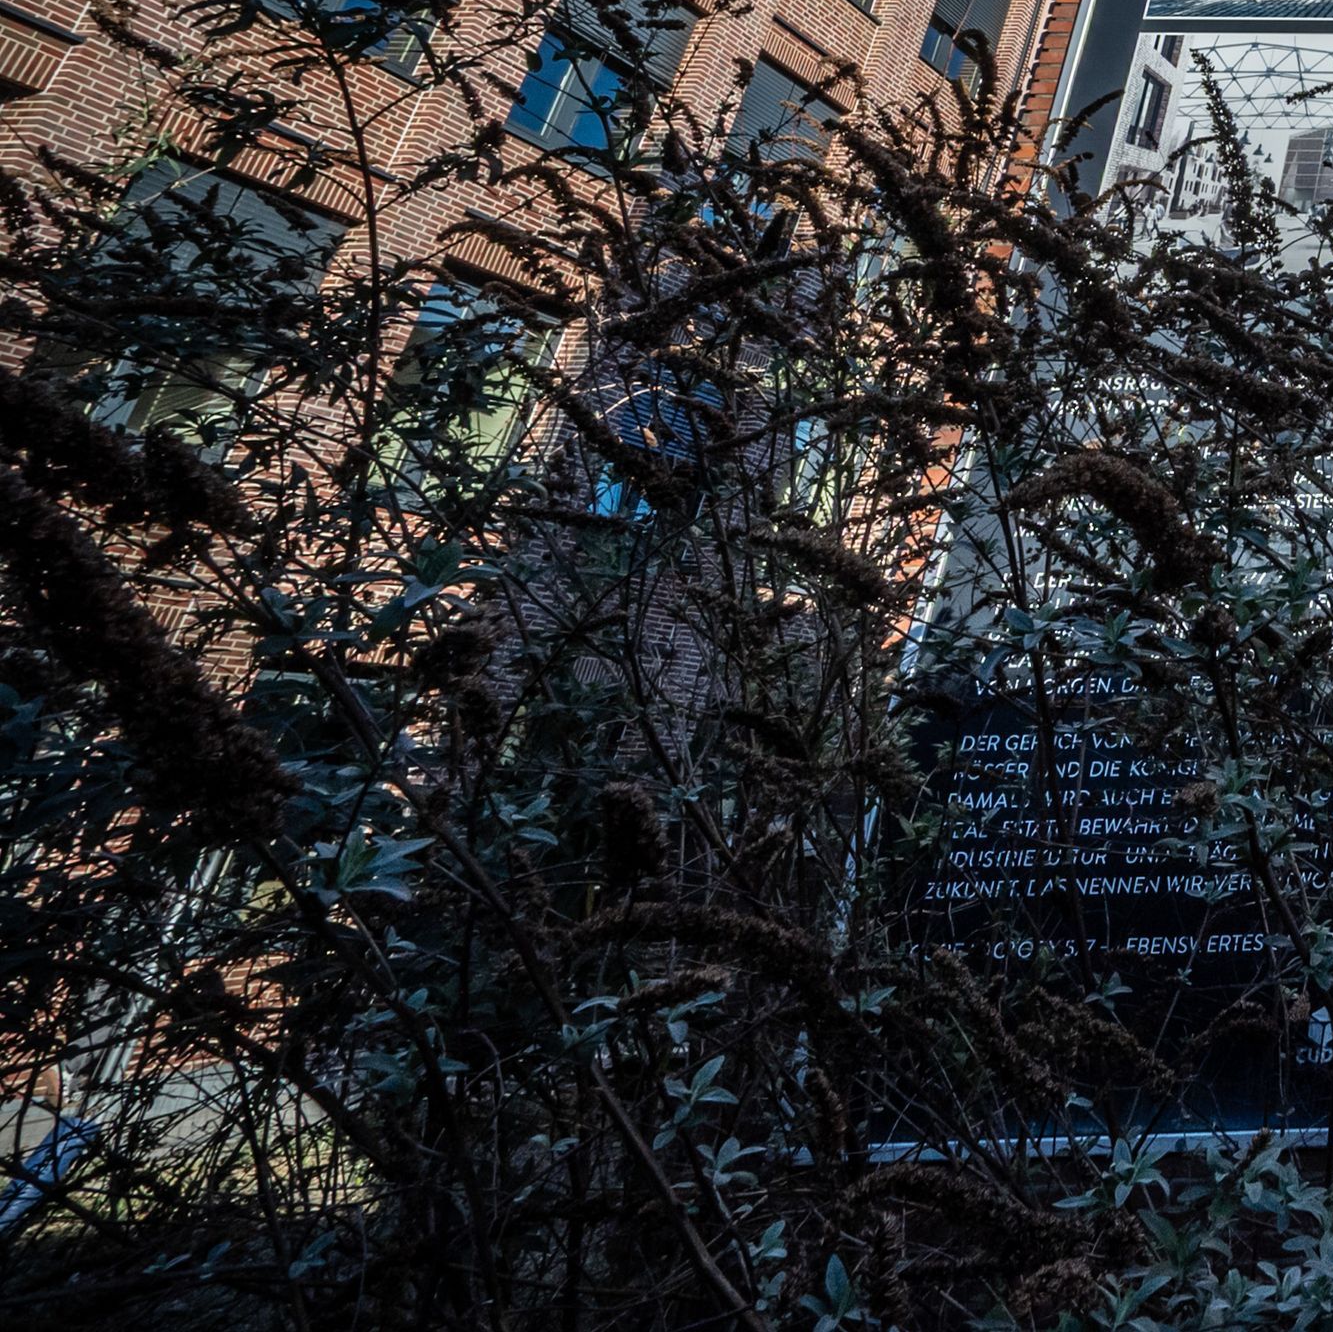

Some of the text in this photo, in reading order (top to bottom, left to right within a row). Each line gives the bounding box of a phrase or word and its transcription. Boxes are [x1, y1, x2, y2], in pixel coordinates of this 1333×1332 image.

[960, 734, 1001, 752] DER
[1004, 732, 1083, 751] GECH
[1041, 760, 1081, 779] ND
[1089, 759, 1122, 778] DIE
[942, 819, 989, 839] EAL
[1110, 933, 1265, 958] EBENSWERTES
